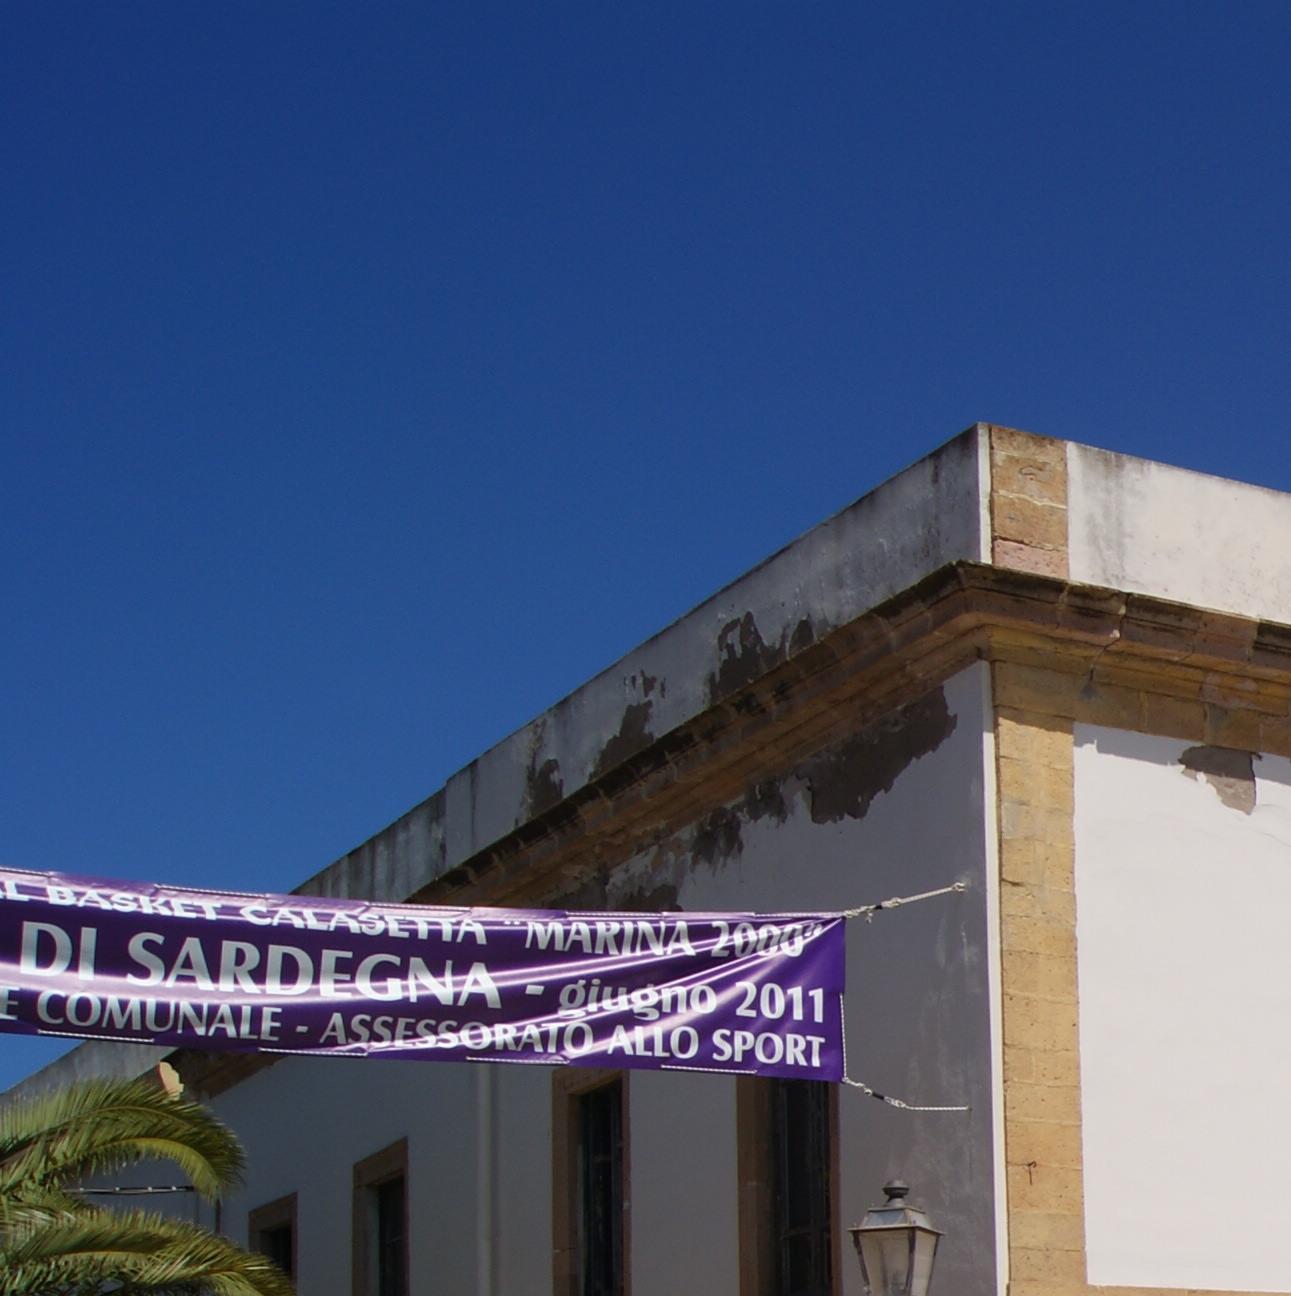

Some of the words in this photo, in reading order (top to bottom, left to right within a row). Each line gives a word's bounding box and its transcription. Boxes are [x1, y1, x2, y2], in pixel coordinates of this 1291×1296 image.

[0, 880, 30, 902] L
[47, 885, 222, 920] BASKET
[239, 904, 487, 945] CALASETTA
[20, 920, 97, 981] DI
[126, 931, 502, 1009] SARDEGNA
[558, 979, 717, 1021] giugno
[735, 981, 823, 1023] 2011
[36, 988, 282, 1041] COMUNALE
[319, 1011, 594, 1053] ASSESSORATO
[607, 1024, 699, 1059] ALLO
[712, 1028, 825, 1068] SPORT
